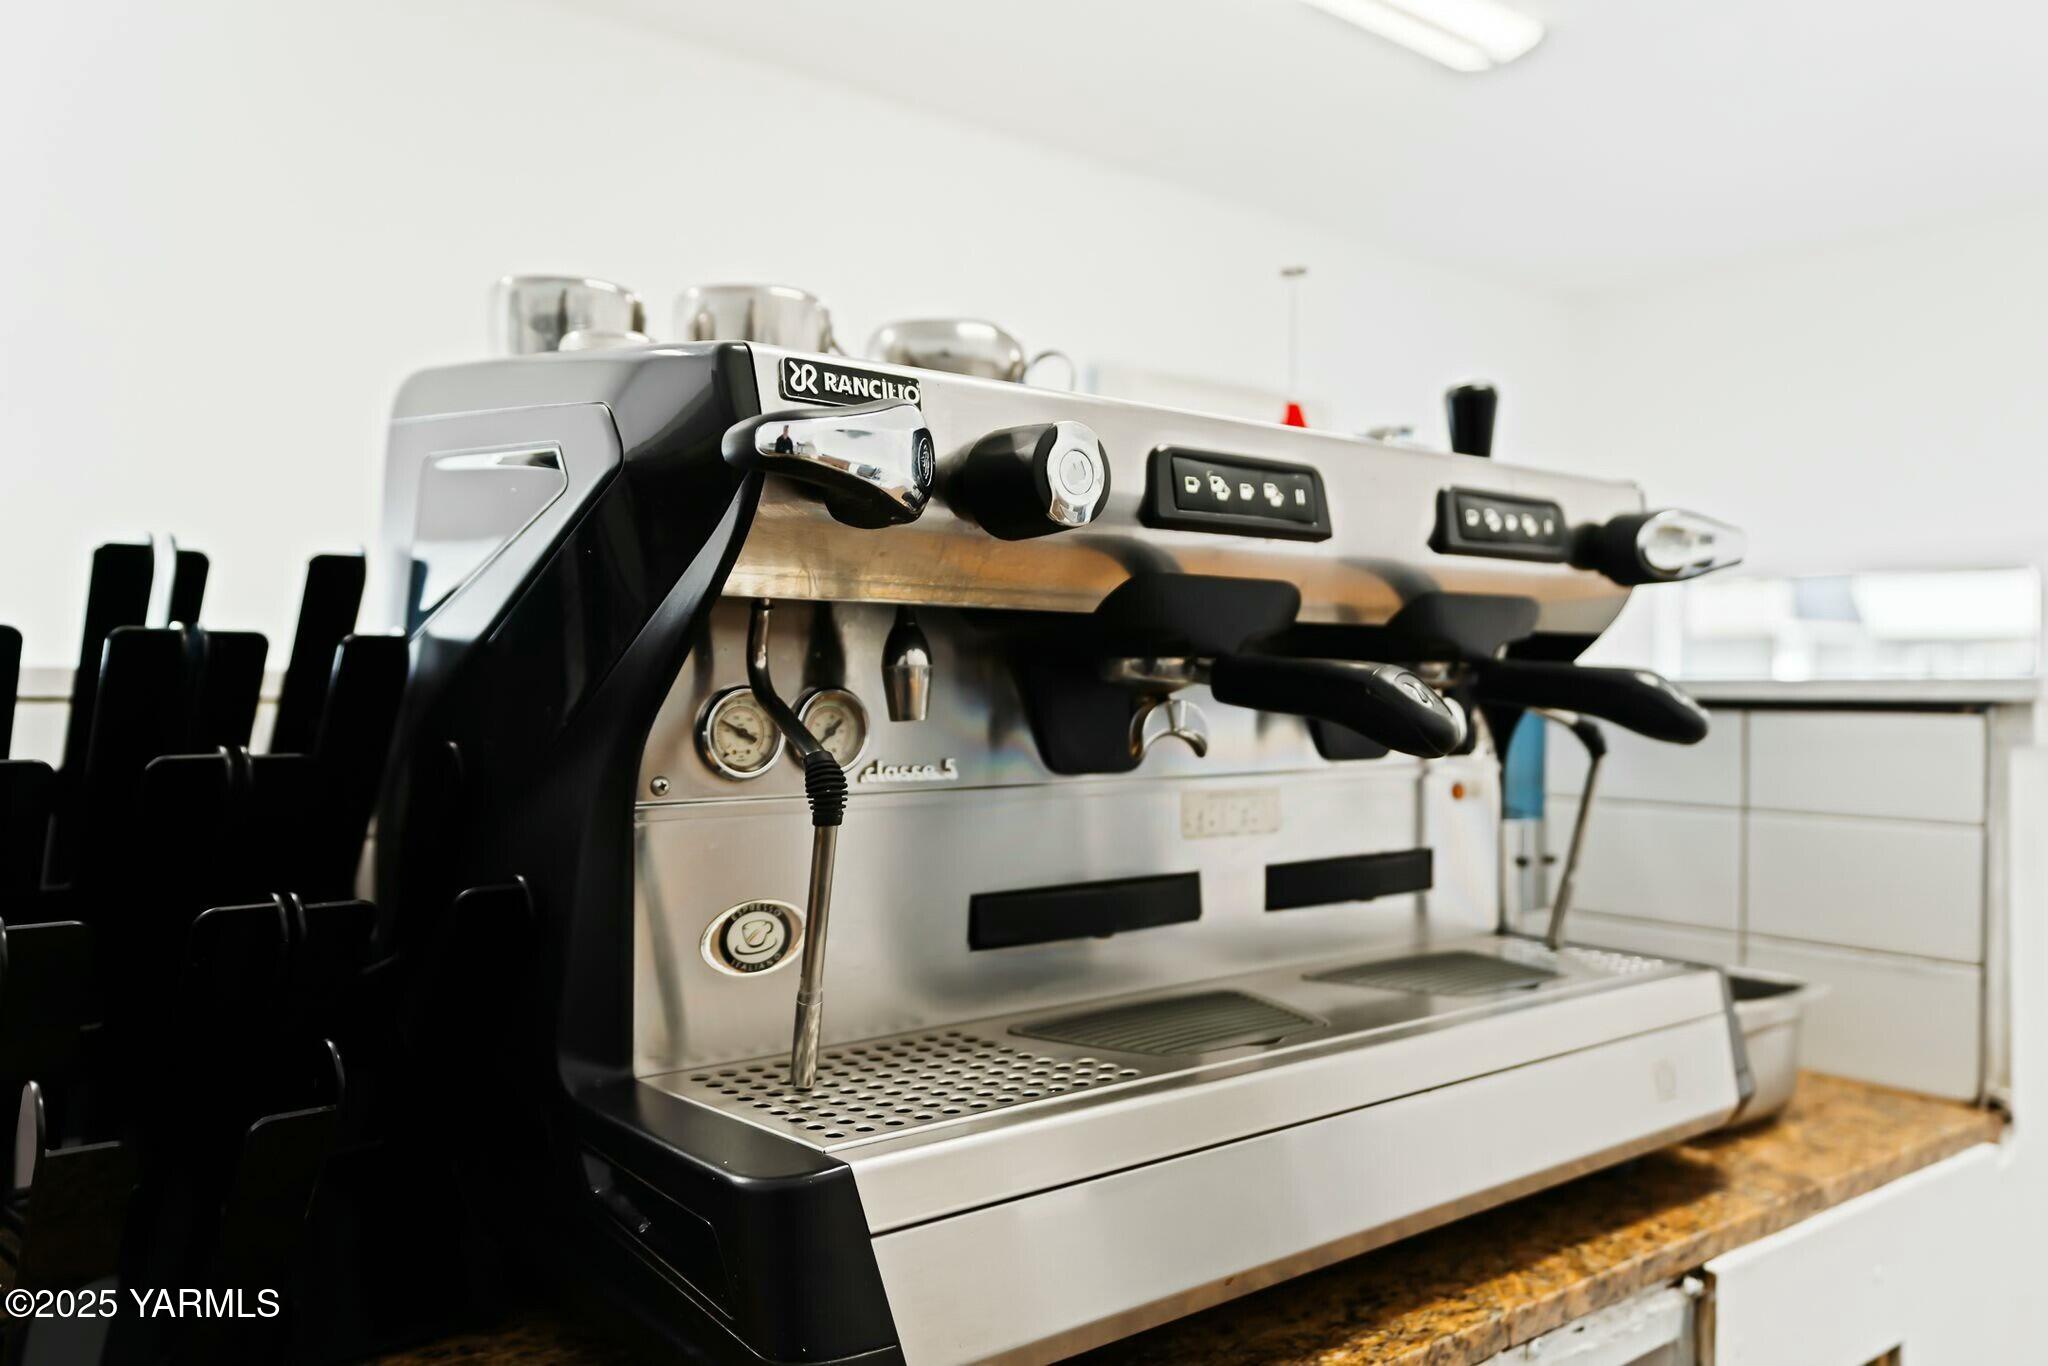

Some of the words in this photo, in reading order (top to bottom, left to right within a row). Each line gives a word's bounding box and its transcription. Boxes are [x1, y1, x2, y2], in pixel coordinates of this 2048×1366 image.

[824, 372, 921, 404] RANCILIO
[731, 903, 782, 921] ESPRESSO
[731, 952, 782, 972] ITALIANO
